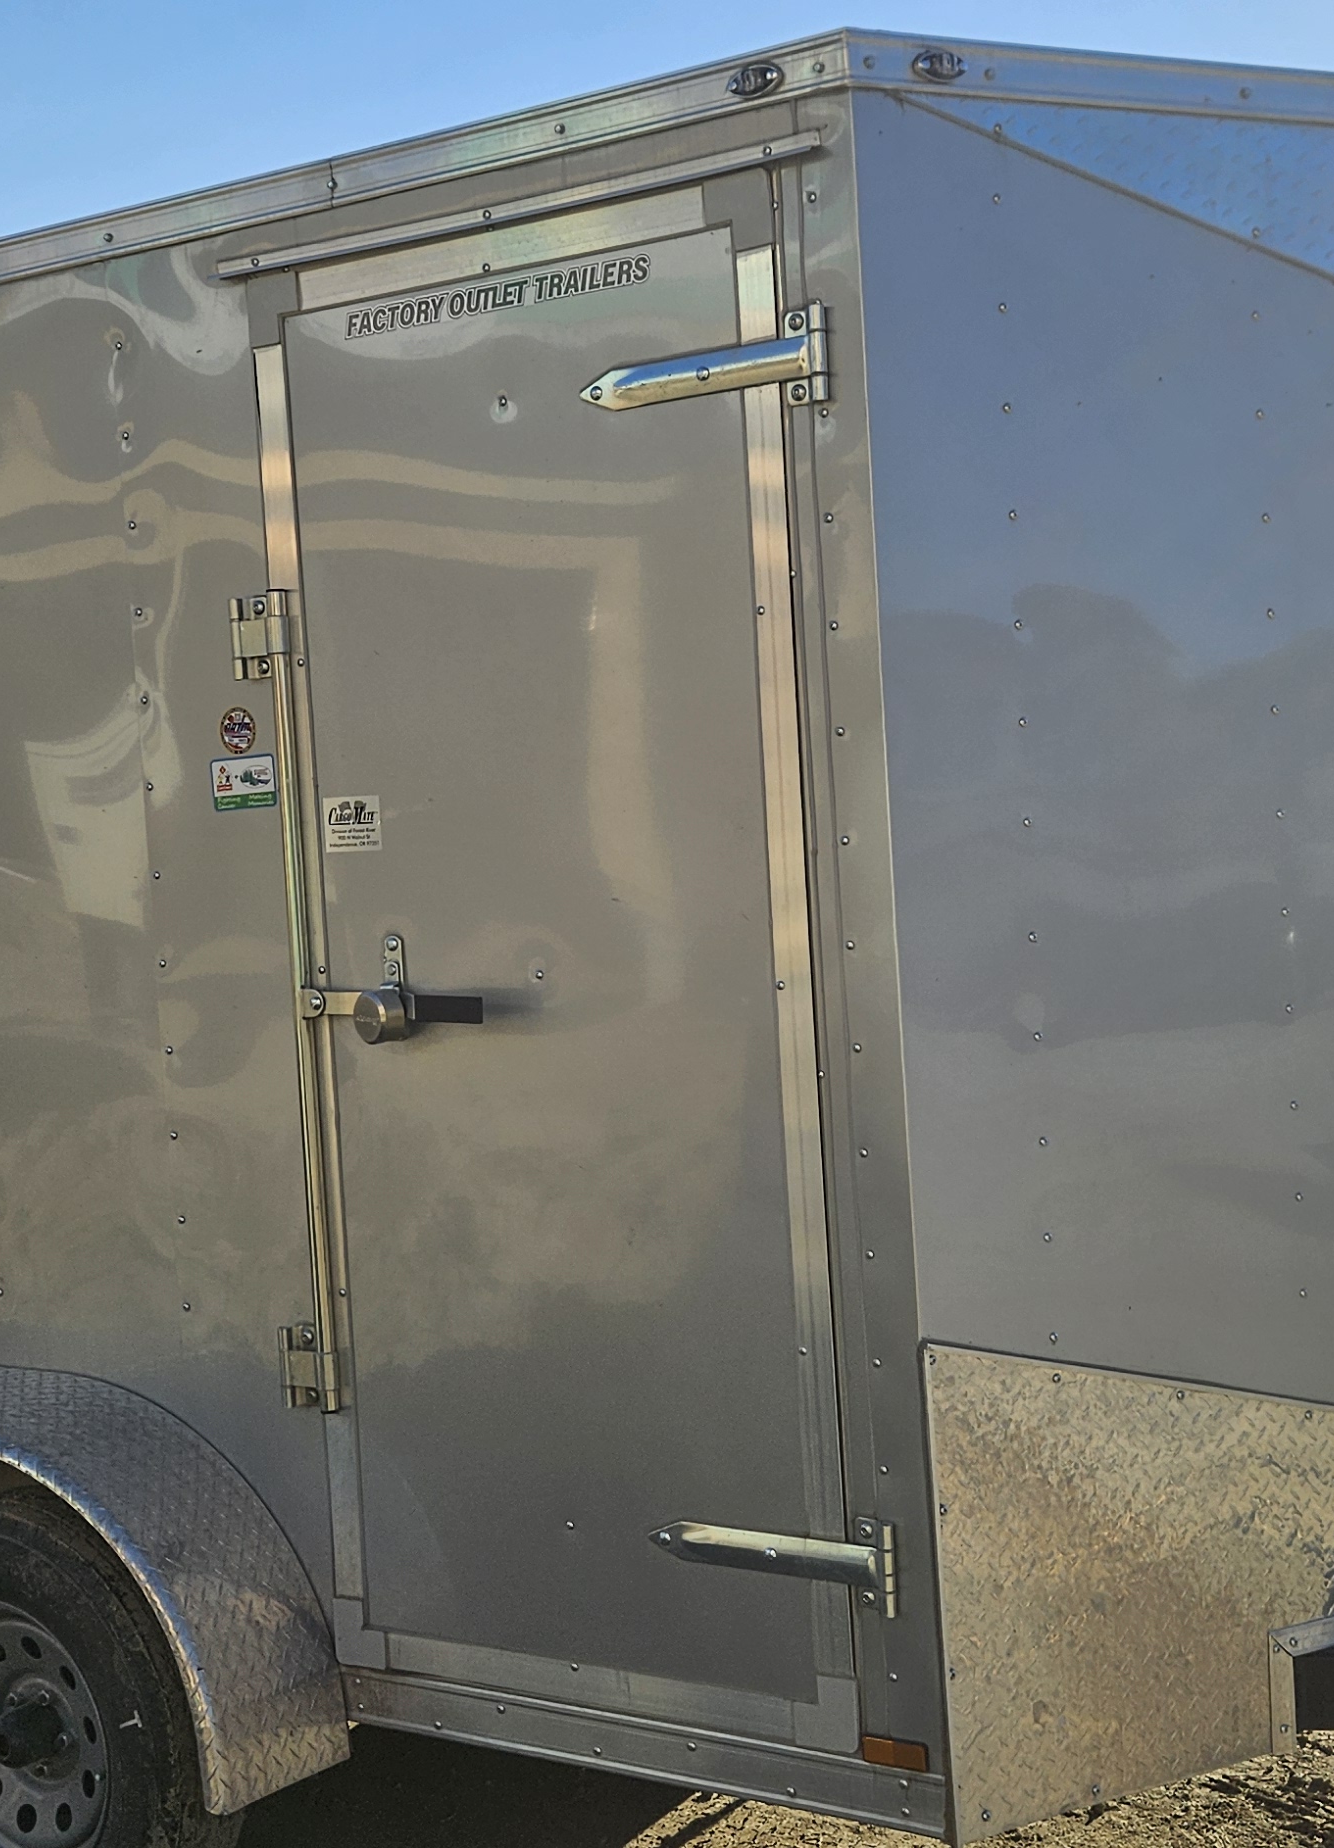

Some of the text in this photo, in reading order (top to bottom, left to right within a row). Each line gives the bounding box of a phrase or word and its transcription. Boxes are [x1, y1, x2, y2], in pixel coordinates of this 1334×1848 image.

[345, 253, 651, 339] FACTORY OUTLET TRAILERS
